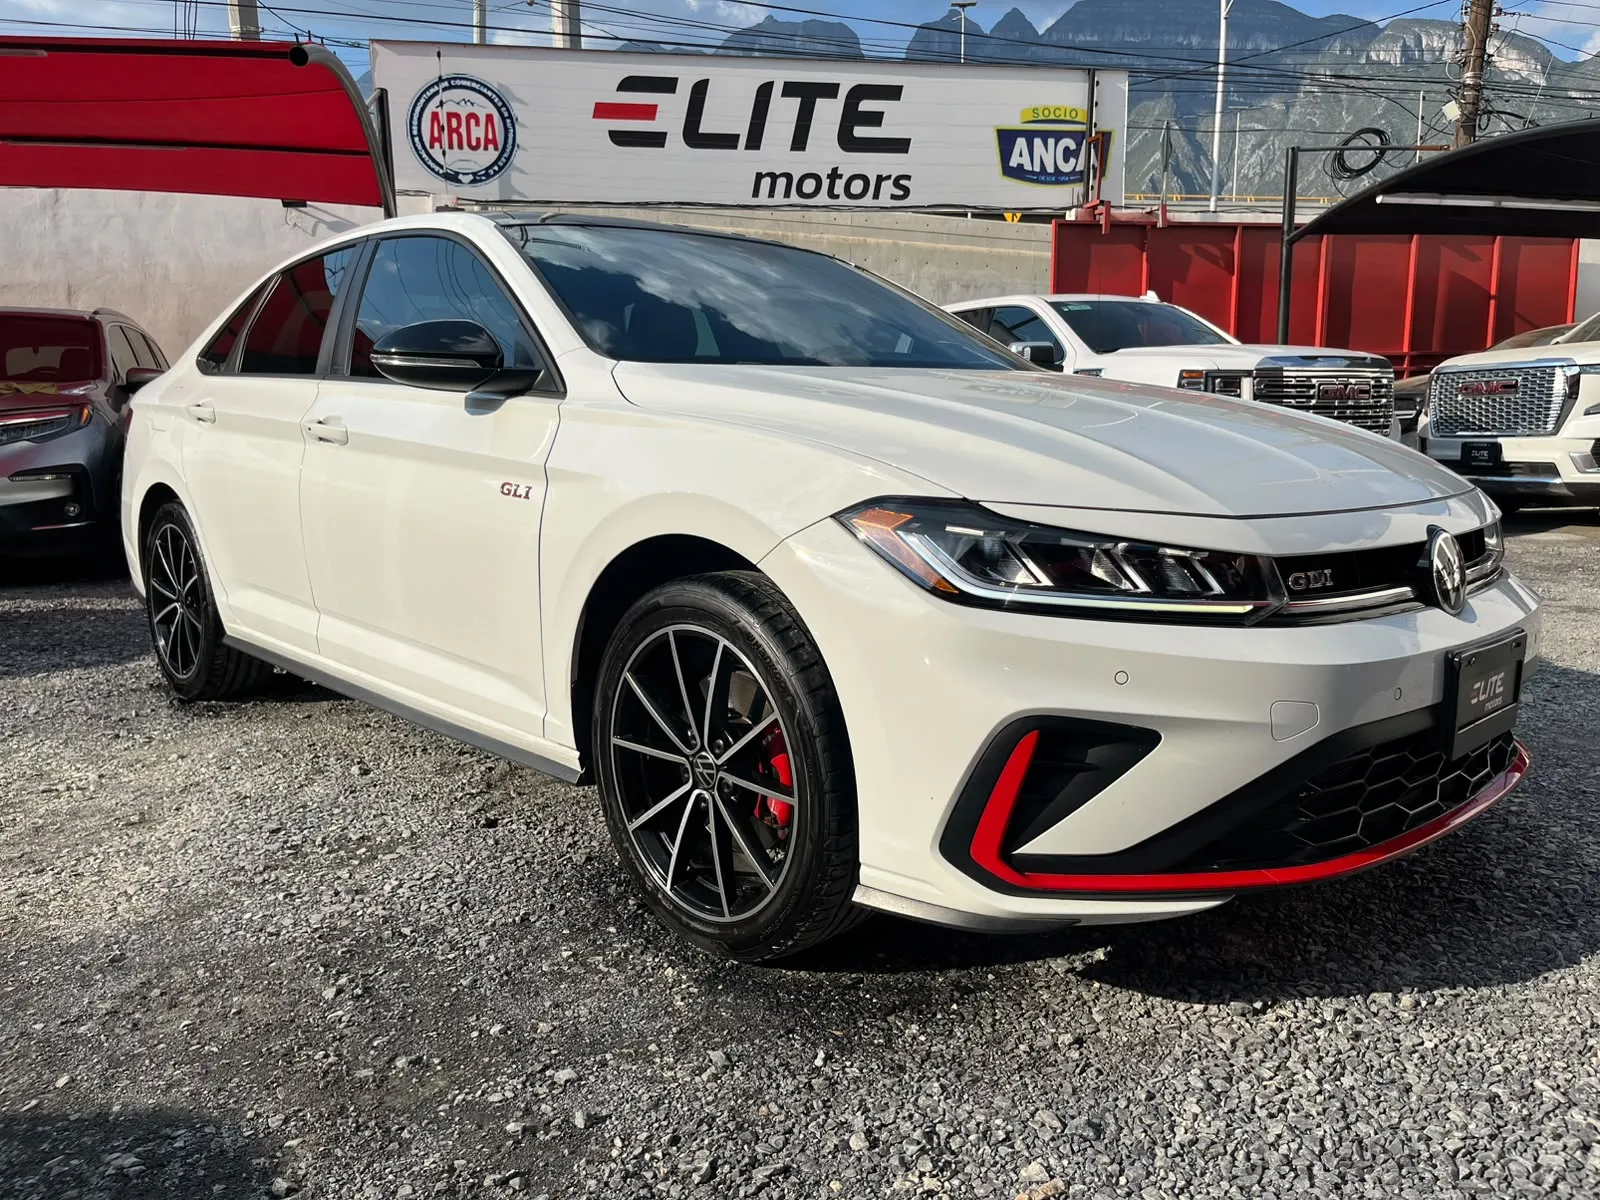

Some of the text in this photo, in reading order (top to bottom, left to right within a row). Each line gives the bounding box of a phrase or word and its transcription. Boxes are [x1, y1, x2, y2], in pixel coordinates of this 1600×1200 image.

[592, 75, 912, 154] ELITE
[1031, 107, 1079, 119] SOCIO
[429, 111, 499, 152] ARCA
[751, 166, 912, 201] motors
[1320, 384, 1370, 400] GMC
[1460, 380, 1516, 396] GMC
[500, 481, 533, 500] GLI
[1470, 671, 1505, 705] ELITE
